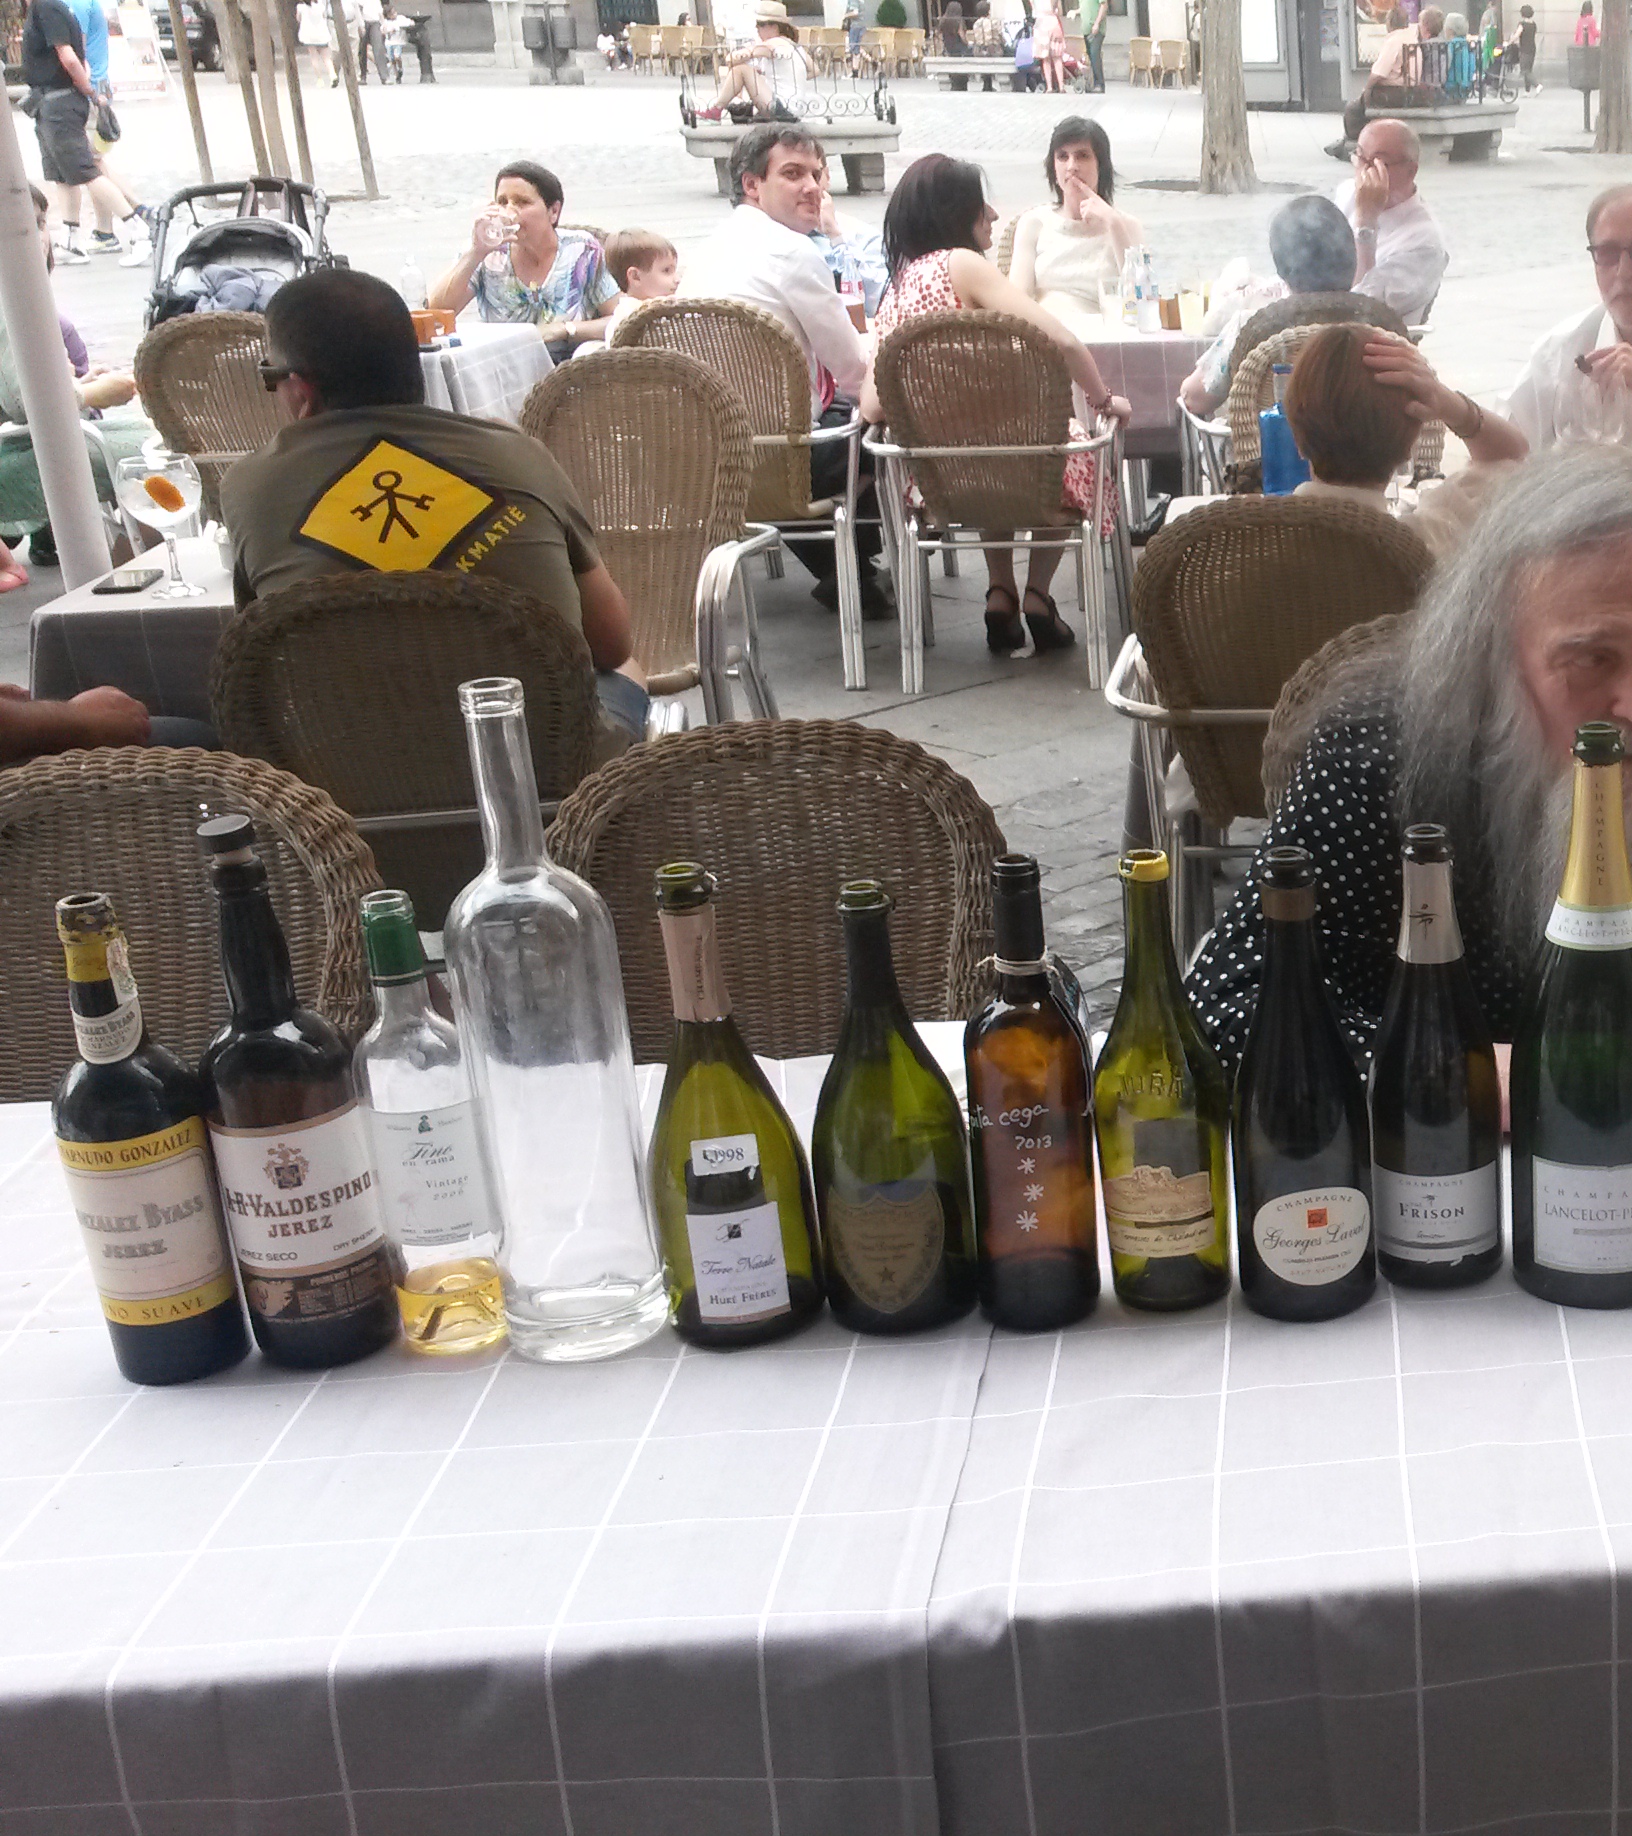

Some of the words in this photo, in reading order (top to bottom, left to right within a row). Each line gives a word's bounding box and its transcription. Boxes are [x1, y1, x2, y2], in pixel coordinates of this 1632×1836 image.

[1117, 1070, 1185, 1100] JURA
[998, 1104, 1050, 1129] cega
[119, 1128, 192, 1163] GONZALEZ
[404, 1141, 454, 1161] Fino
[425, 1155, 455, 1167] rama
[425, 1174, 470, 1189] Vintage
[1400, 1179, 1463, 1188] CHAMPAGNE
[141, 1193, 204, 1229] BYASS
[1276, 1194, 1353, 1212] CHAMPAGNE
[1399, 1201, 1465, 1219] FRISON
[267, 1214, 334, 1239] JEREZ
[1262, 1226, 1322, 1256] Georges
[1326, 1212, 1367, 1244] Laval
[102, 1238, 168, 1259] JEREZ
[333, 1240, 350, 1251] DRY
[265, 1251, 298, 1262] SECO
[141, 1296, 206, 1320] SUAVE
